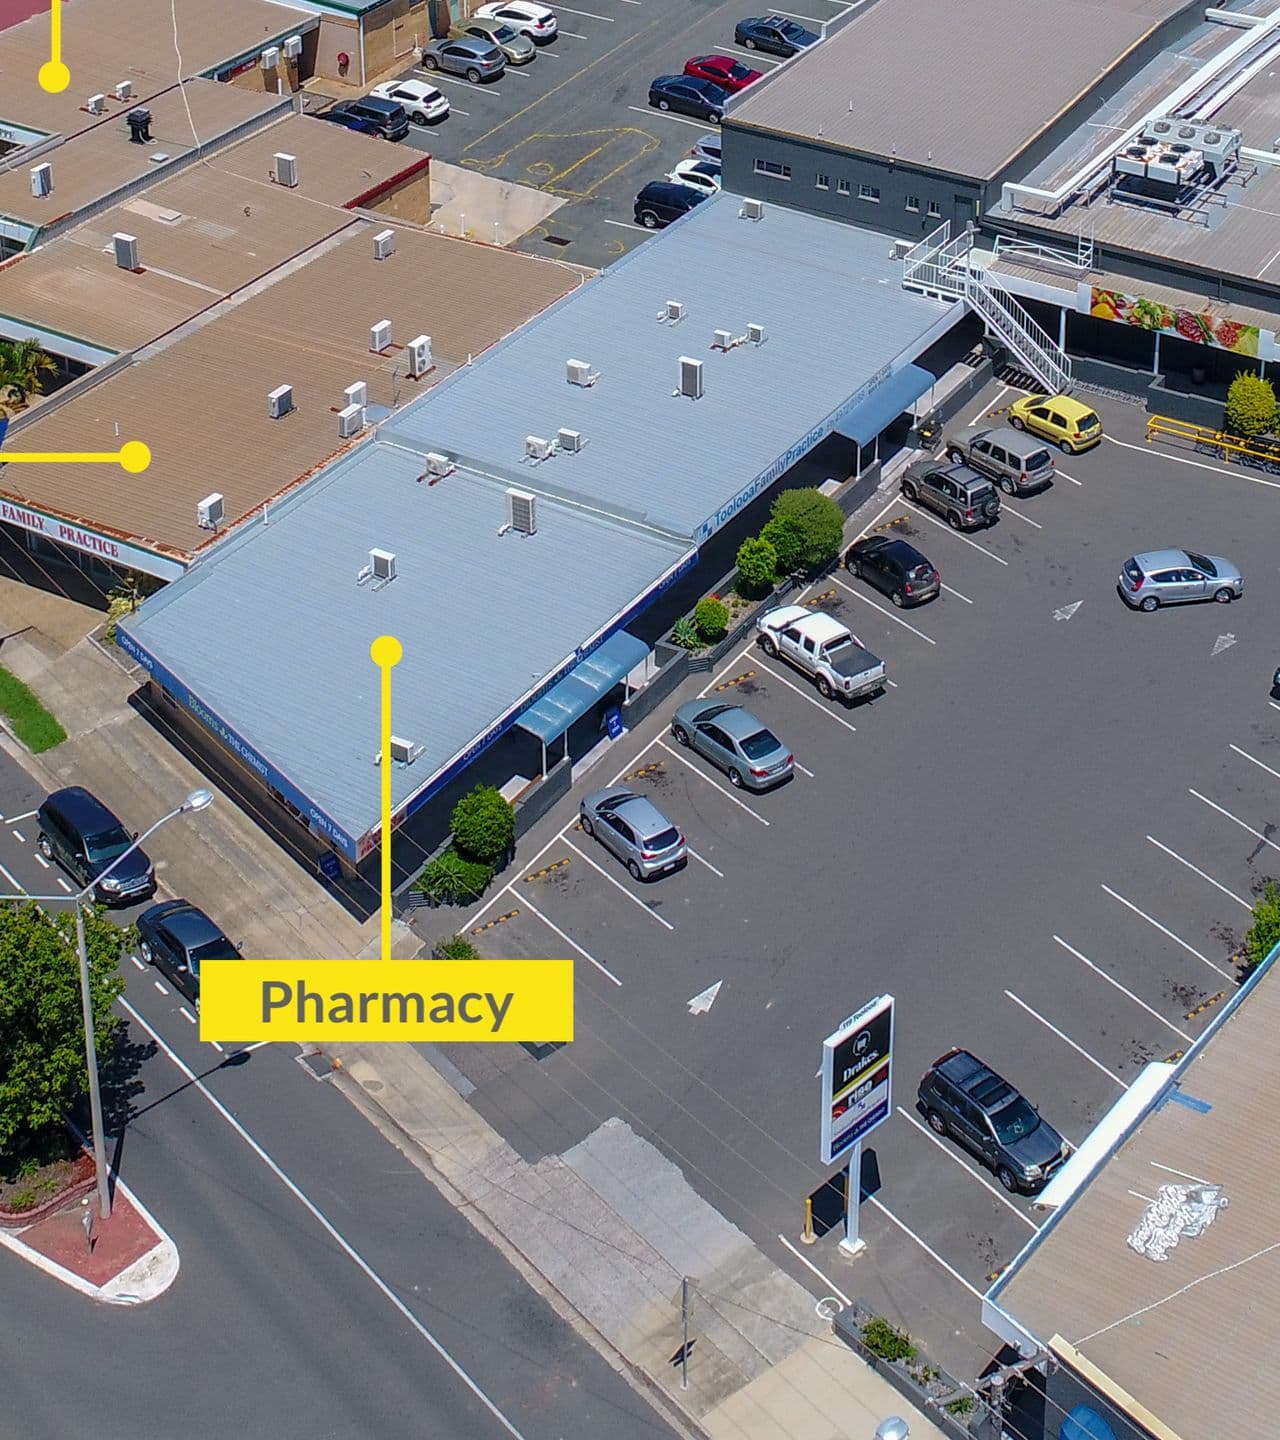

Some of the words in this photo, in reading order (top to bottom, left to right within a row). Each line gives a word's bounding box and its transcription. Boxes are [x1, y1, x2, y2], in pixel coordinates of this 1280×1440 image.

[1, 503, 45, 531] FAMILY
[59, 524, 120, 558] PRACTICE
[188, 694, 219, 732] Blooms
[310, 808, 327, 829] OPEN
[332, 828, 349, 848] DAYS
